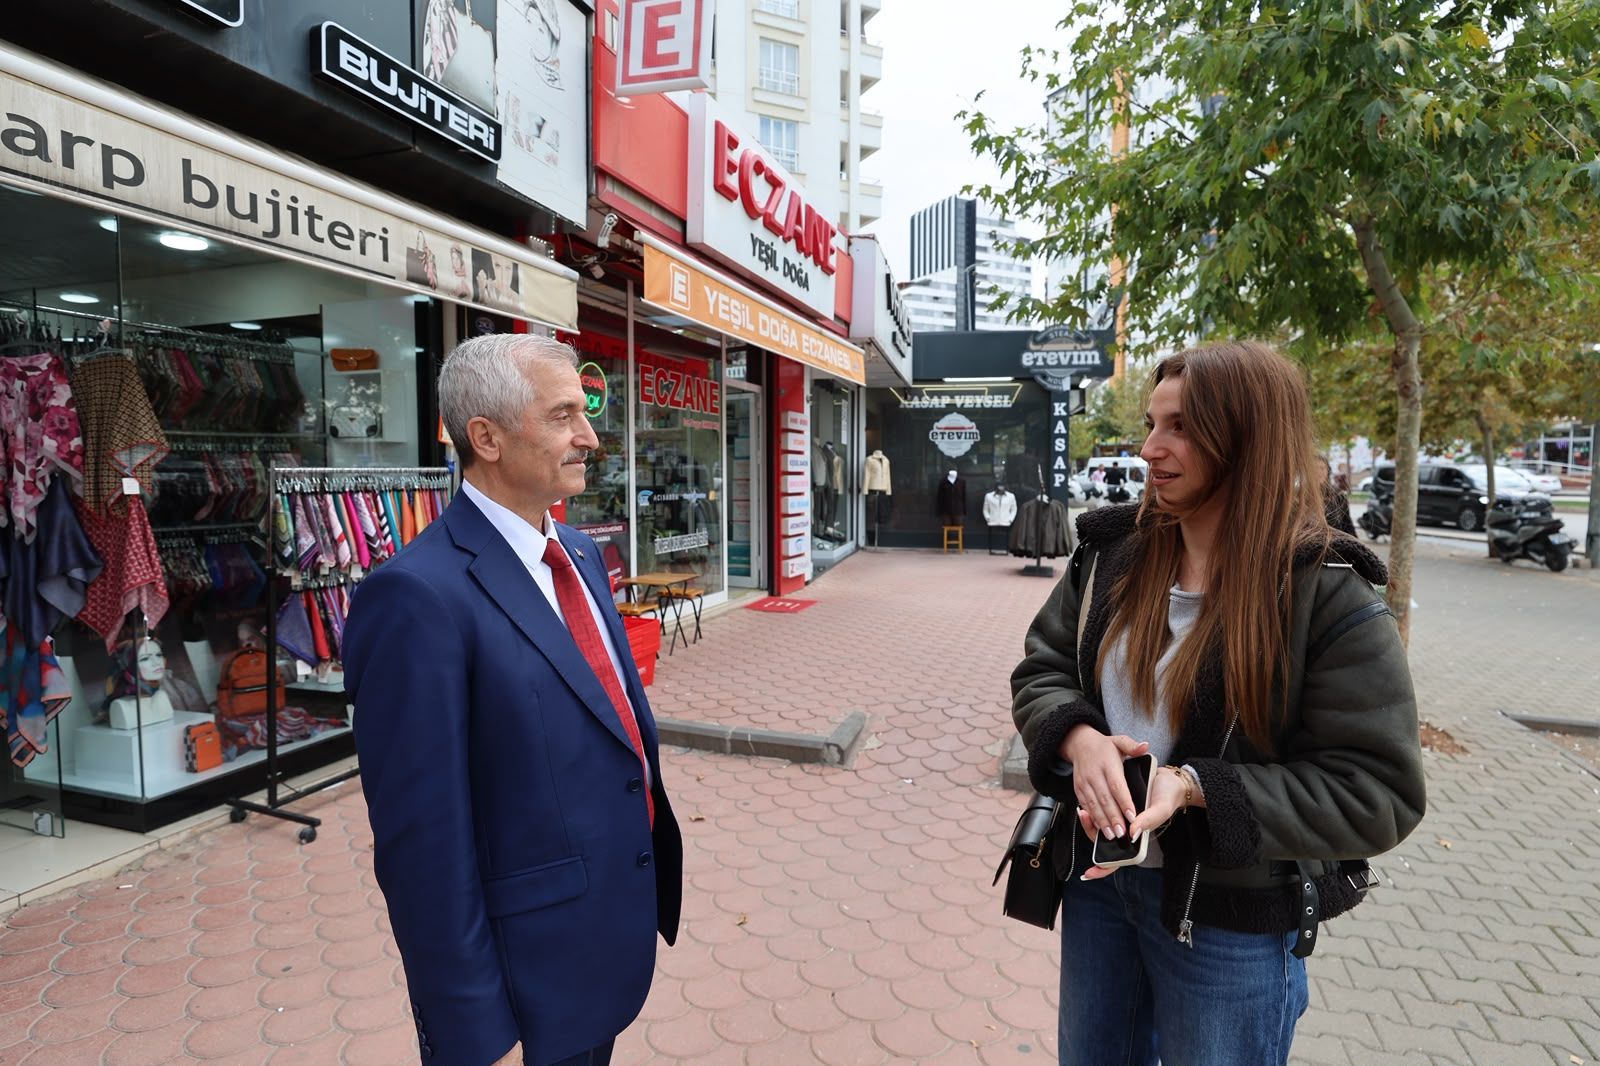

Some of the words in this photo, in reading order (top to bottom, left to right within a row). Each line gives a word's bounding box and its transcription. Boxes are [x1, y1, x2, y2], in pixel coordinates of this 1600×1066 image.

[642, 1, 682, 69] E
[181, 158, 389, 263] bujiteri
[714, 119, 837, 276] ECZANE
[750, 232, 779, 271] YEŞİL
[783, 256, 809, 292] DOĞA
[758, 312, 799, 351] DOĞA
[639, 363, 720, 415] ECZANE
[954, 395, 1013, 408] VEYSEL
[1053, 402, 1067, 487] KASAP
